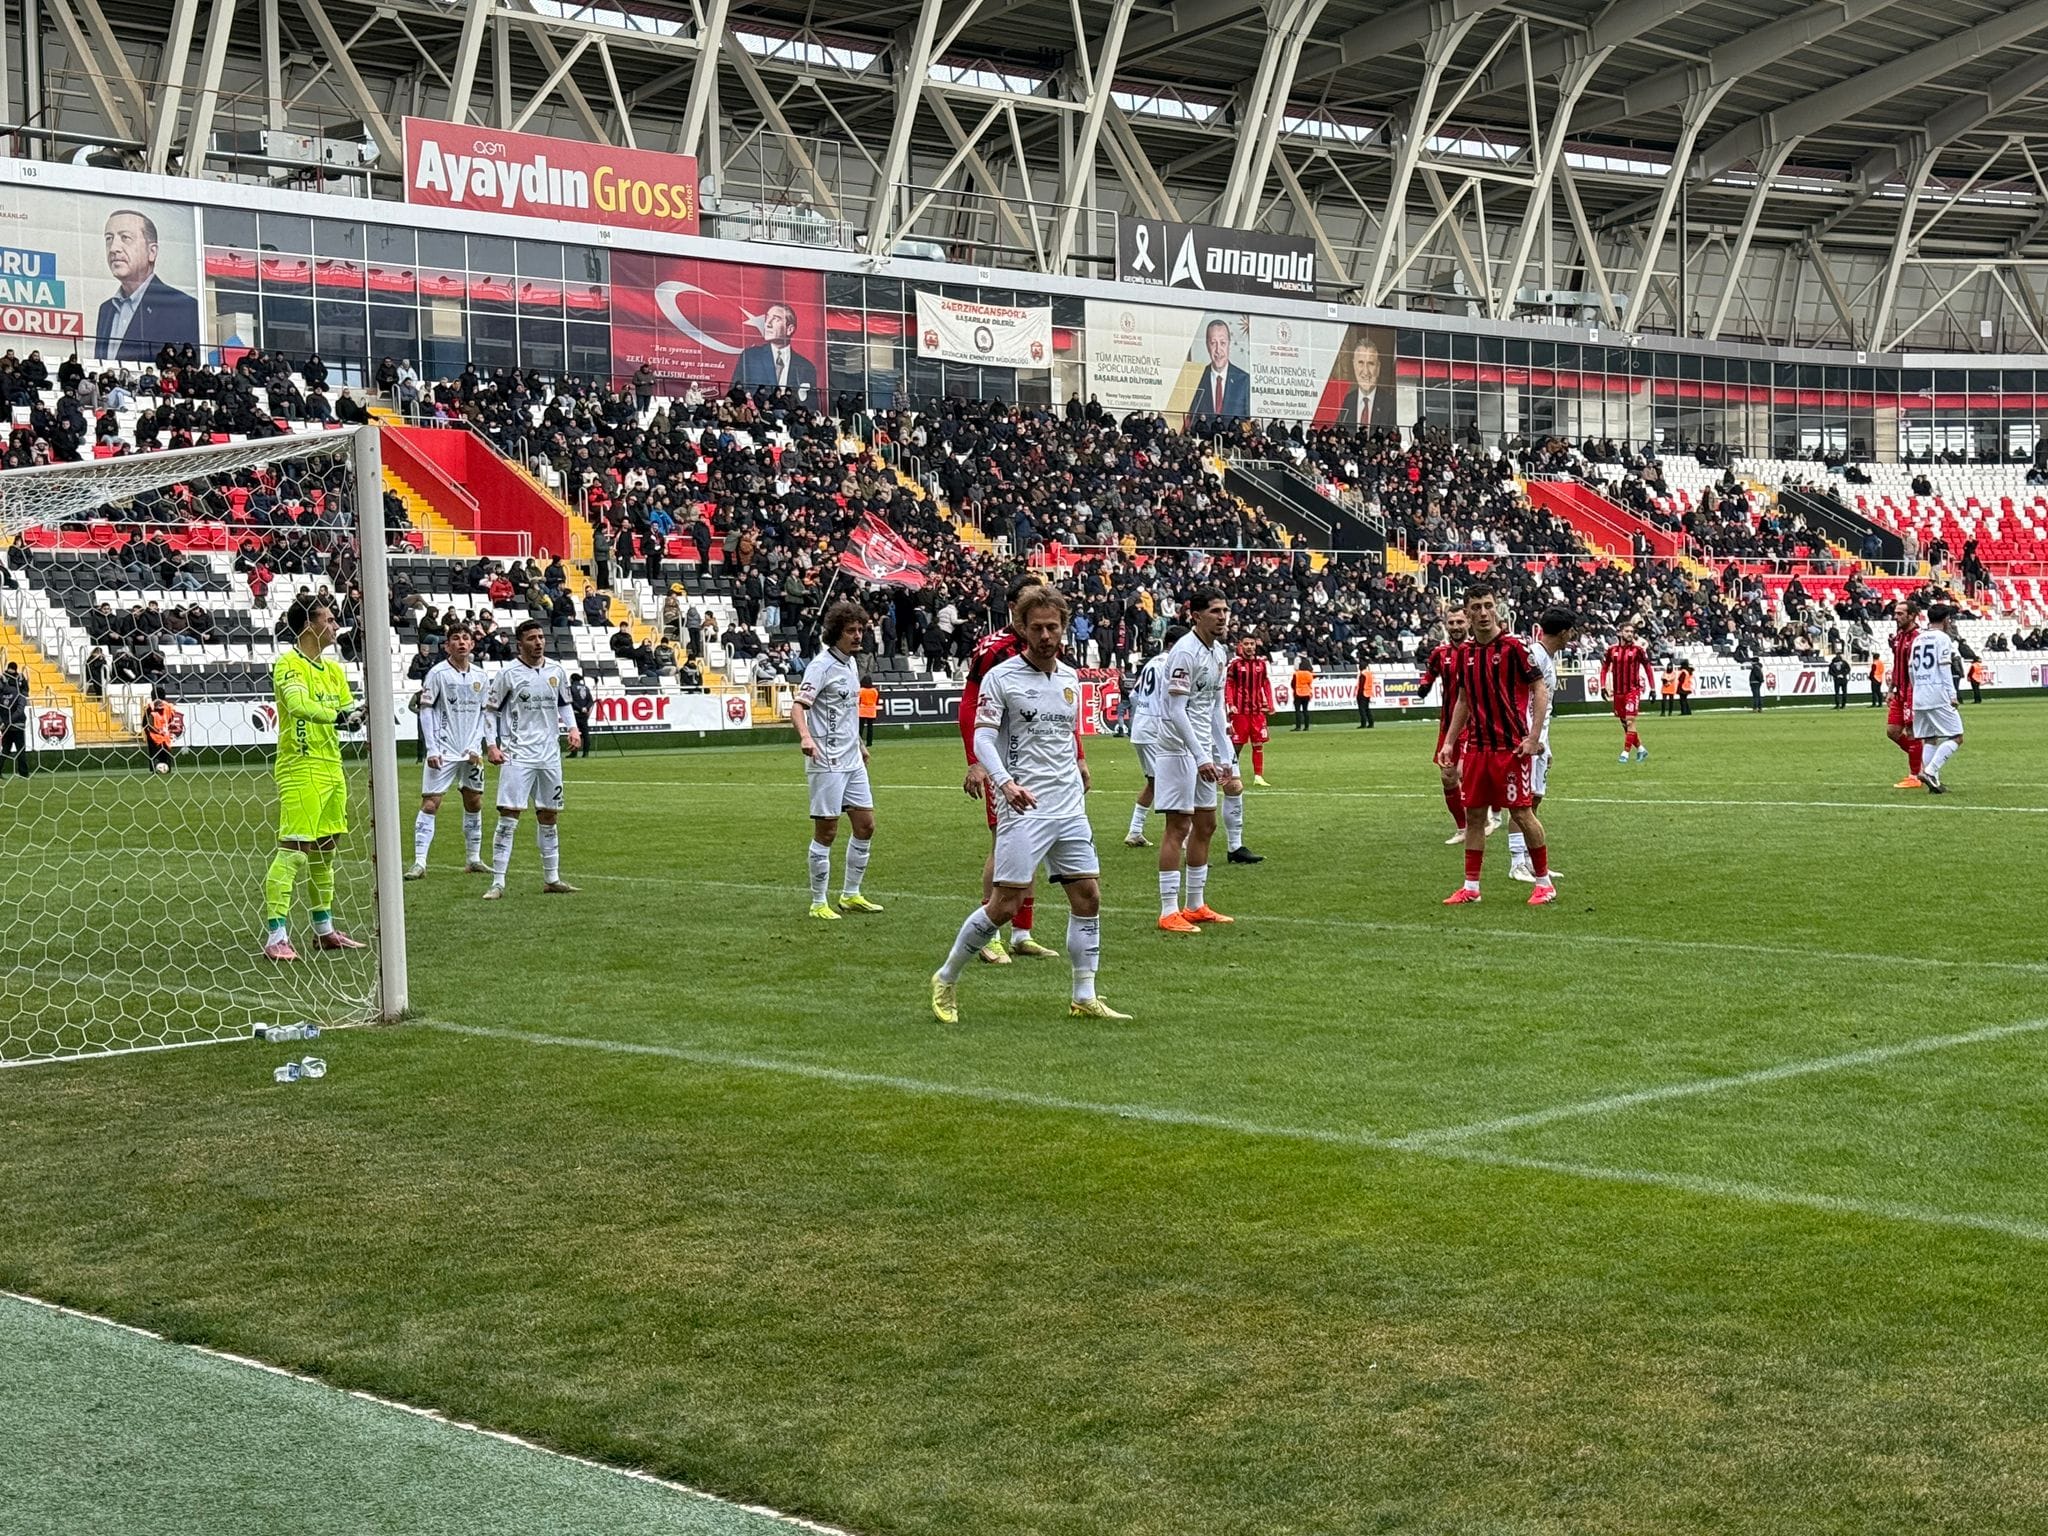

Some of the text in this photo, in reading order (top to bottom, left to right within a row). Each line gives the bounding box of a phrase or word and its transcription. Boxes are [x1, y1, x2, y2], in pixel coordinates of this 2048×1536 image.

[22, 167, 38, 178] 103
[415, 139, 687, 220] Ayaydın Gross
[0, 251, 41, 277] RU
[1206, 247, 1314, 283] anagold
[1095, 352, 1161, 367] TÜM ANTRENÖR VE
[1097, 363, 1159, 376] SPORCULARIMIZA
[1252, 364, 1317, 378] TÜM ANTRENÖR VE
[1094, 374, 1163, 386] BAŞARILAR DİLİYORUM
[1254, 376, 1315, 388] SPORCULARIMIZA
[1252, 386, 1318, 397] BAŞARILAR DİLİYORUM
[1912, 644, 1935, 671] 55
[1384, 681, 1419, 693] GOODYEA
[1009, 735, 1019, 766] ASTOR
[1507, 784, 1517, 802] 8
